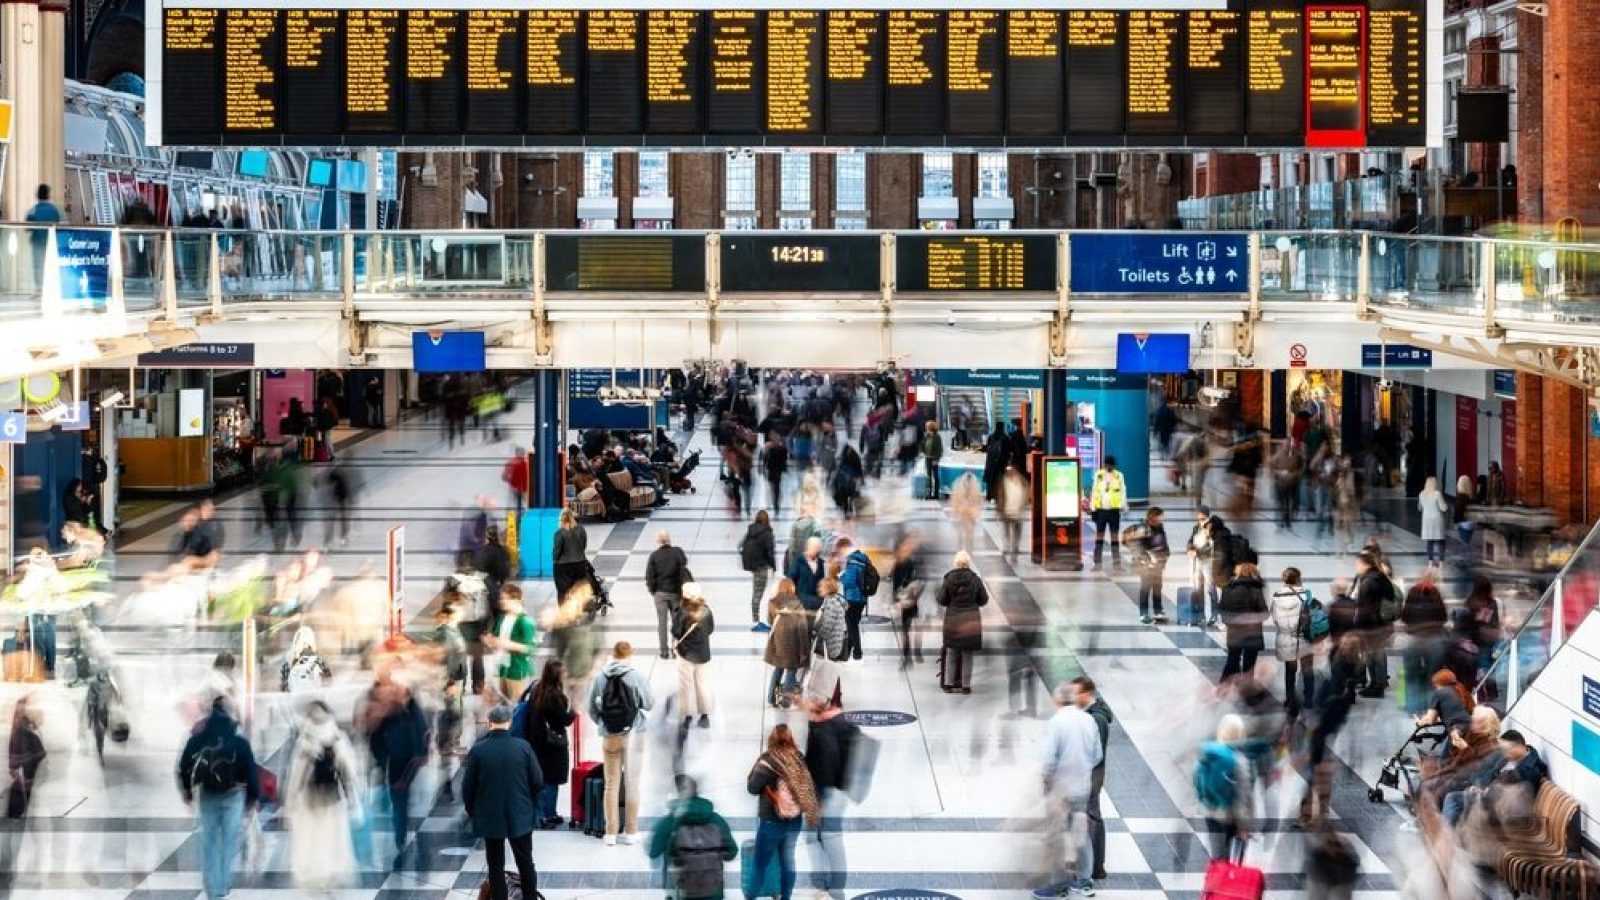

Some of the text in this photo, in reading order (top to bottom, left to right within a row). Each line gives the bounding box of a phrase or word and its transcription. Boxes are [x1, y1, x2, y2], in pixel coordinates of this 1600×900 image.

[771, 246, 809, 262] 14:21
[1163, 243, 1189, 258] Lift
[1119, 268, 1170, 282] Toilets
[228, 346, 238, 354] 17
[4, 417, 17, 436] 6
